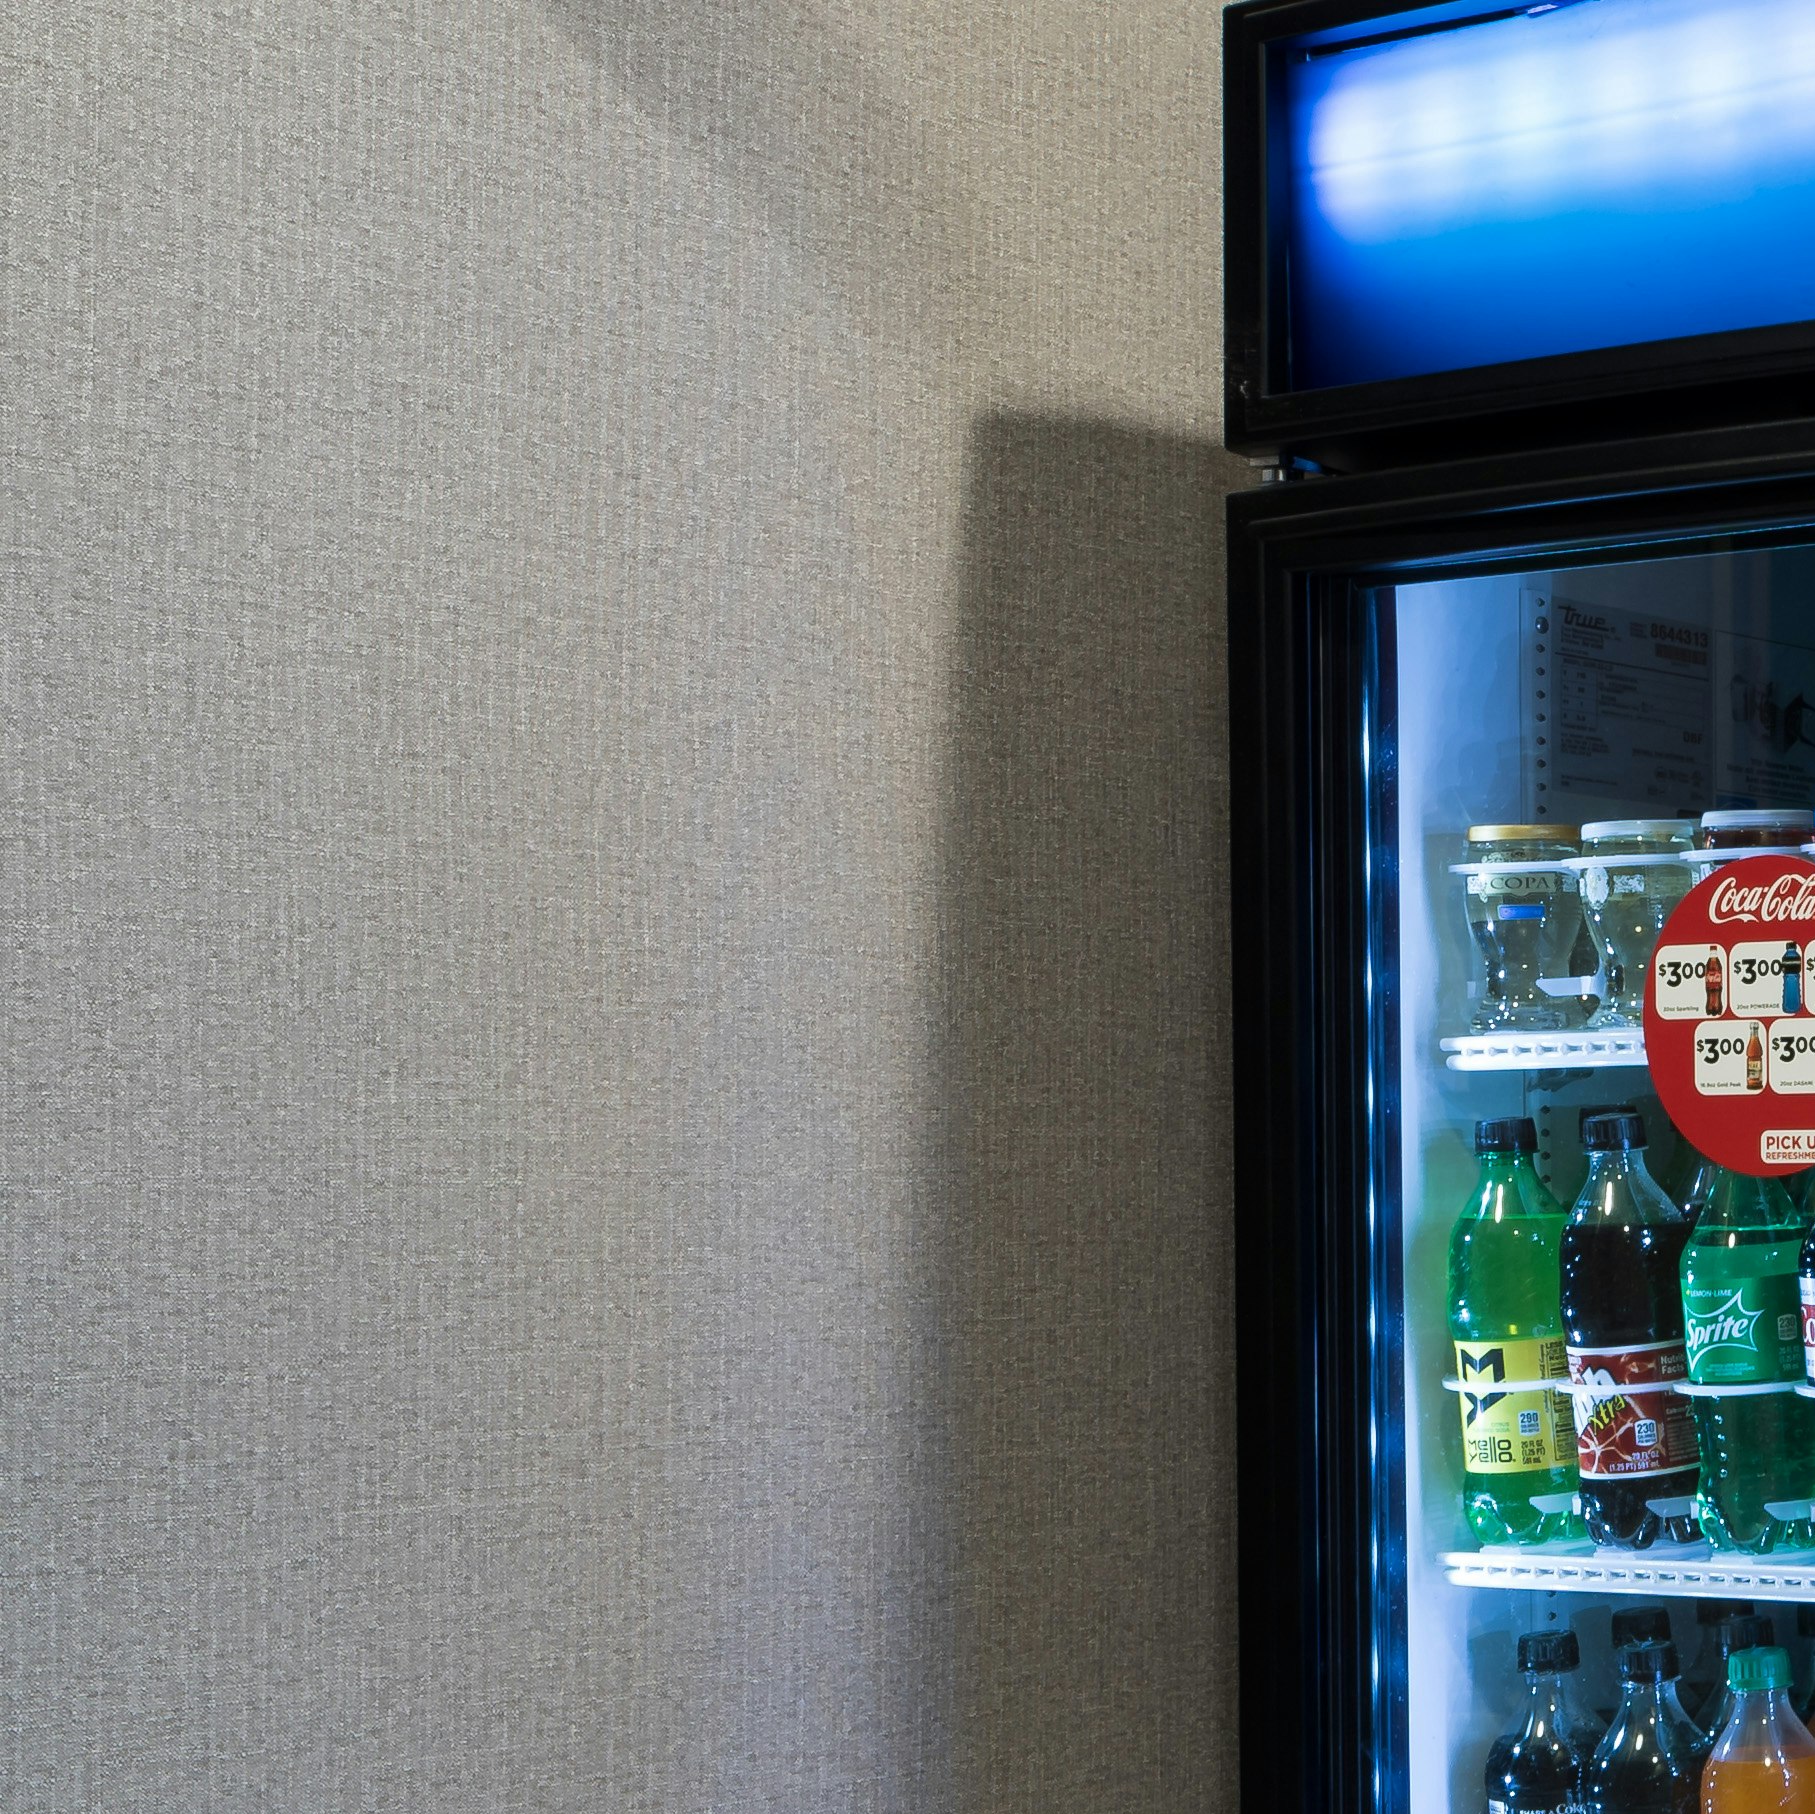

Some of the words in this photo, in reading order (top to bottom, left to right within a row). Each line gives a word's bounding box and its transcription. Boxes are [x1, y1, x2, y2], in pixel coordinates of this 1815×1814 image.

[1490, 875, 1550, 890] COPA
[1766, 1136, 1801, 1151] PICK
[1687, 1315, 1749, 1346] Sprite
